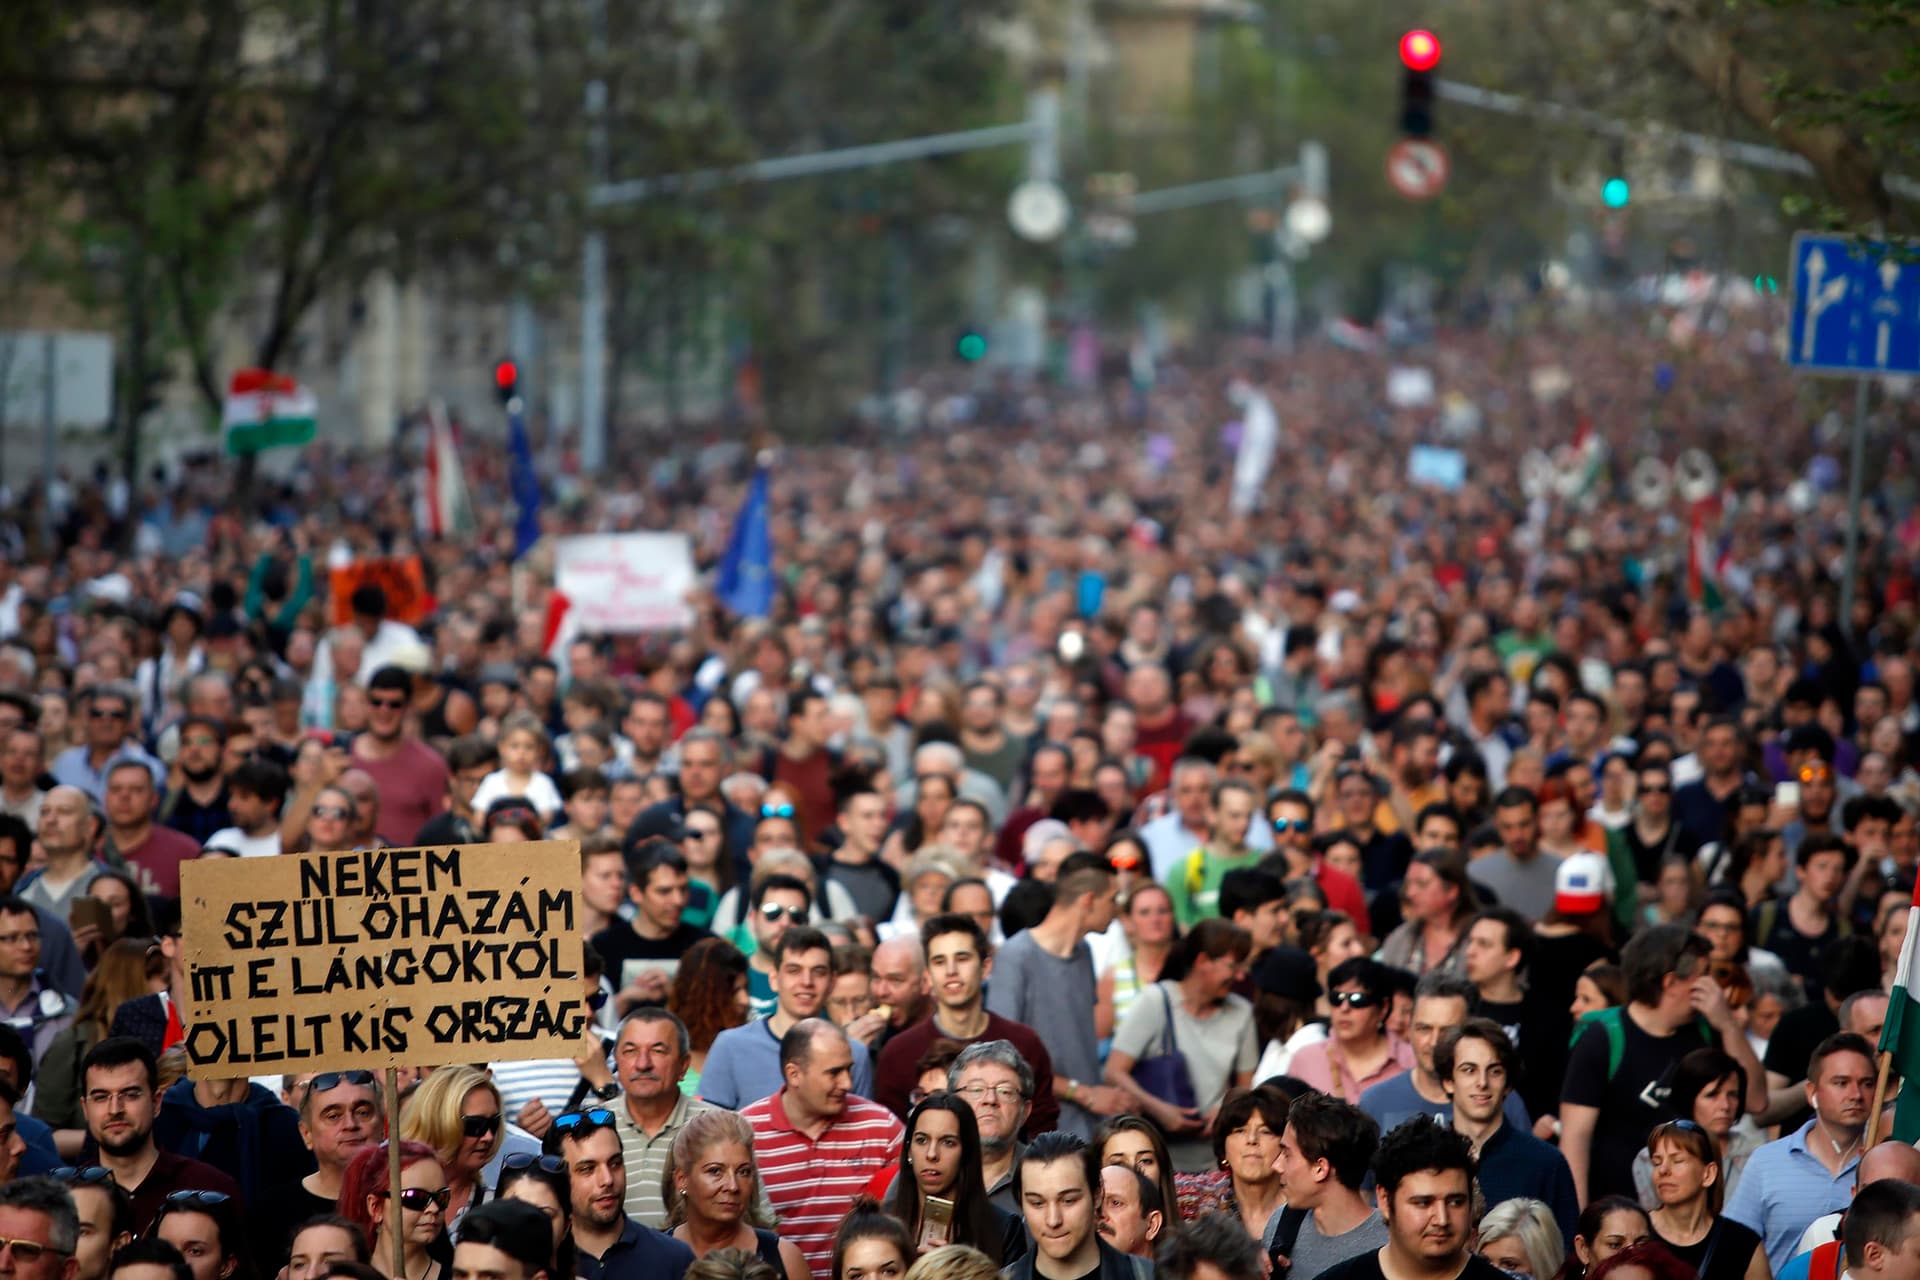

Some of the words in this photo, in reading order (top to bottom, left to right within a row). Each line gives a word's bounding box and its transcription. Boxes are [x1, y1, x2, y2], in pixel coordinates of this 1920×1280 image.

[300, 849, 462, 899] NEKEM
[248, 957, 279, 999] E
[292, 930, 577, 996] LÁNGOKTÓL
[185, 1010, 331, 1065] ÖLELT
[425, 985, 585, 1044] ORSZÁG
